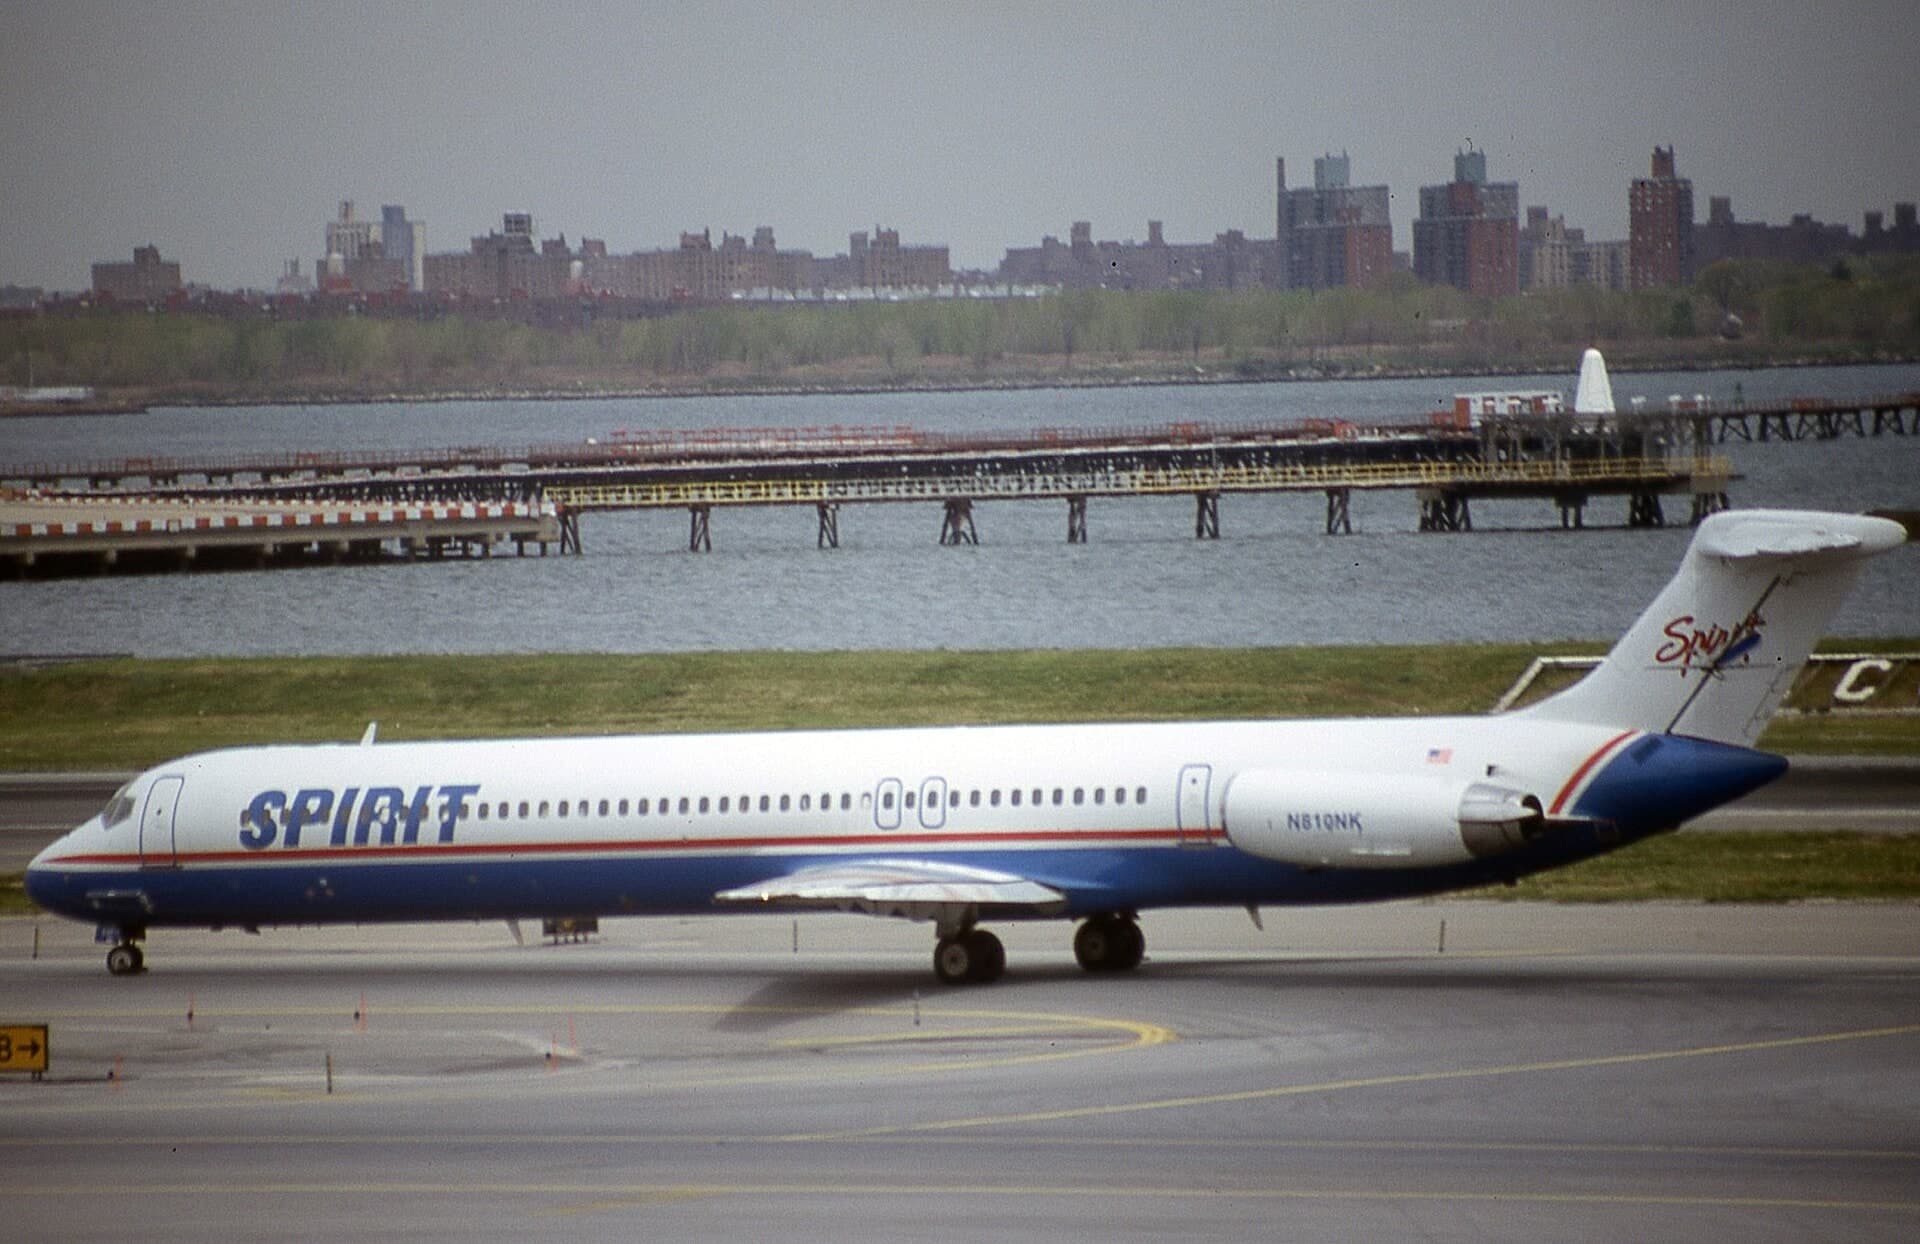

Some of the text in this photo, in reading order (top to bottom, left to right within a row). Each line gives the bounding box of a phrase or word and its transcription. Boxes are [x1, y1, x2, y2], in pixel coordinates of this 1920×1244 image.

[1834, 660, 1892, 701] C
[239, 785, 481, 849] SPIRIT
[1286, 811, 1363, 834] N810NK
